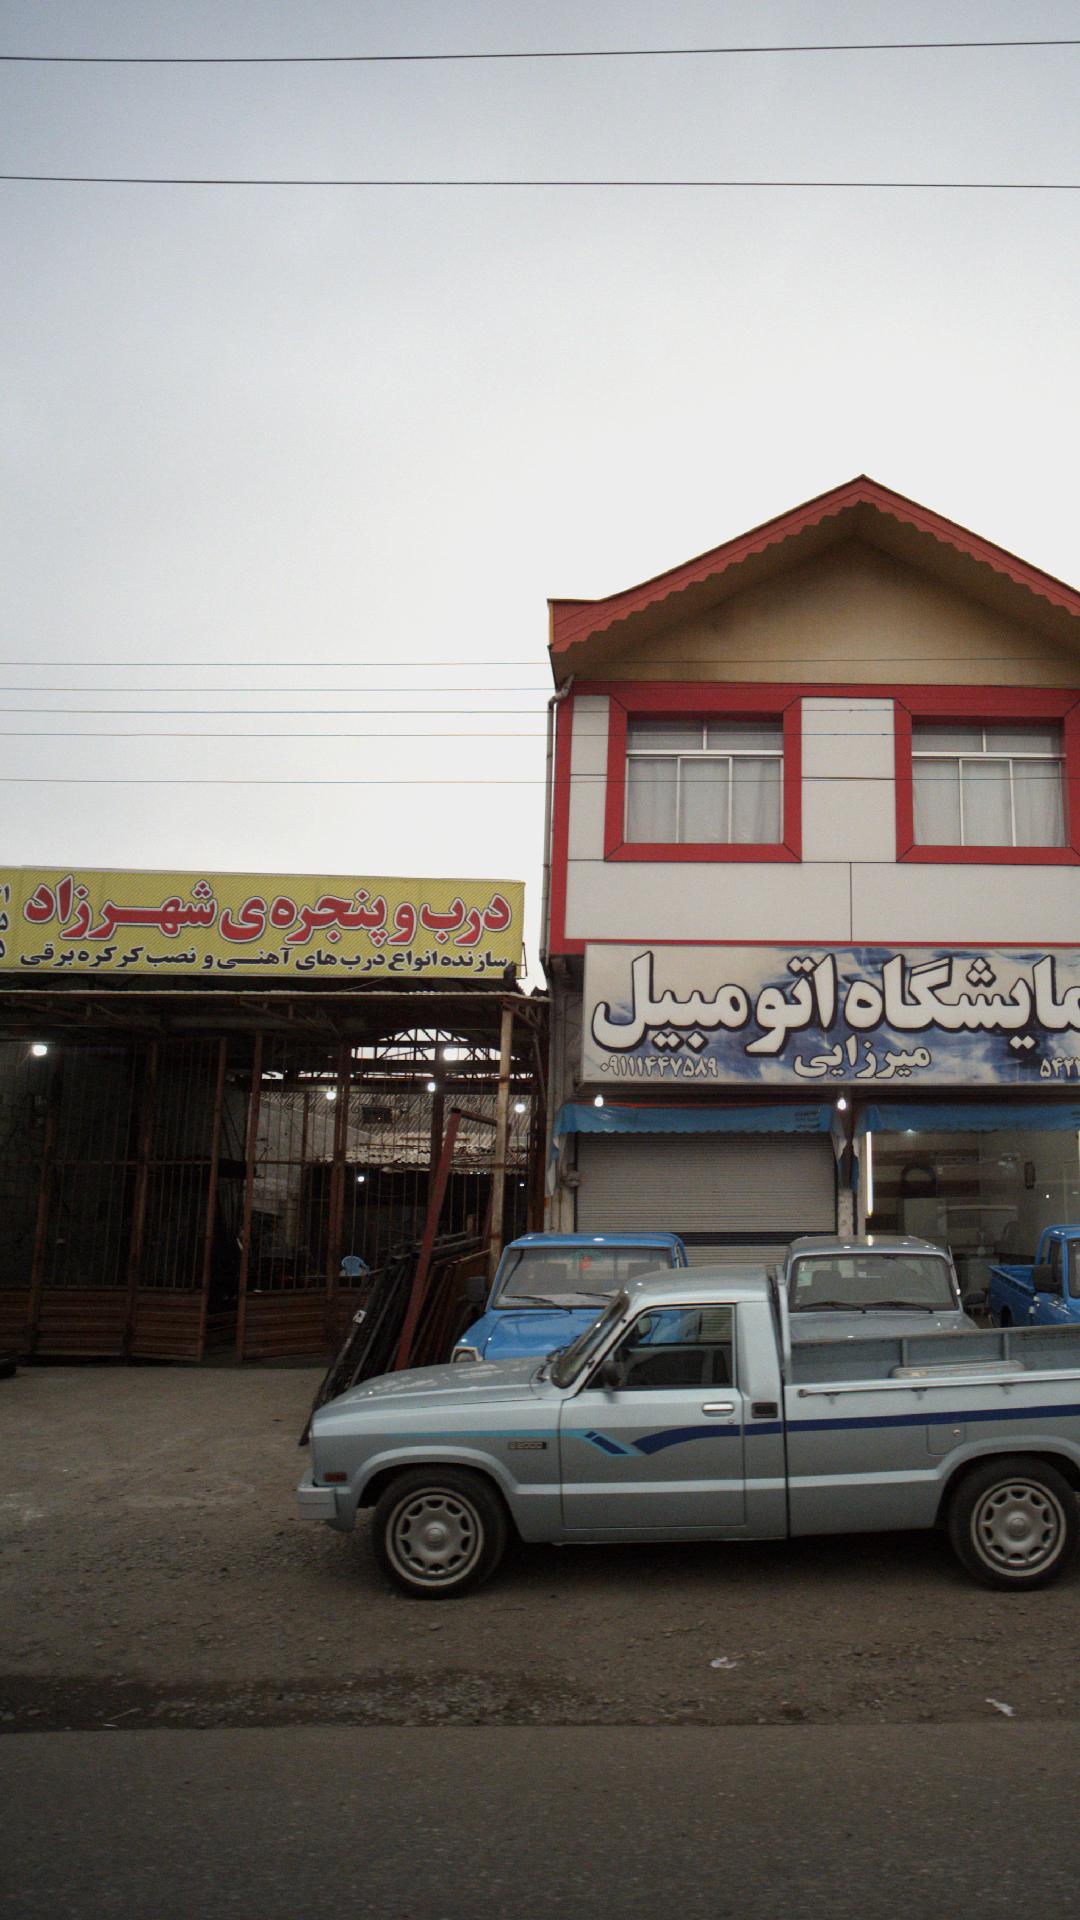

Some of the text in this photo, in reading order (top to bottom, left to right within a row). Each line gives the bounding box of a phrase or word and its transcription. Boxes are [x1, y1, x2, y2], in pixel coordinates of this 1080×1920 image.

[23, 874, 217, 940] شهرزاد
[387, 902, 417, 946] و
[420, 893, 511, 946] درب
[20, 943, 75, 966] برقی
[146, 947, 196, 967] نصب
[201, 954, 214, 970] و
[217, 947, 293, 969] آهنی
[388, 950, 438, 971] انواع
[440, 950, 507, 972] سازنده
[591, 950, 1080, 1056] مایشگاه اتومبیل
[599, 1055, 718, 1078] ۰۹۱۱۱۴۴۷۵۸۹
[793, 1033, 932, 1079] میرزایی
